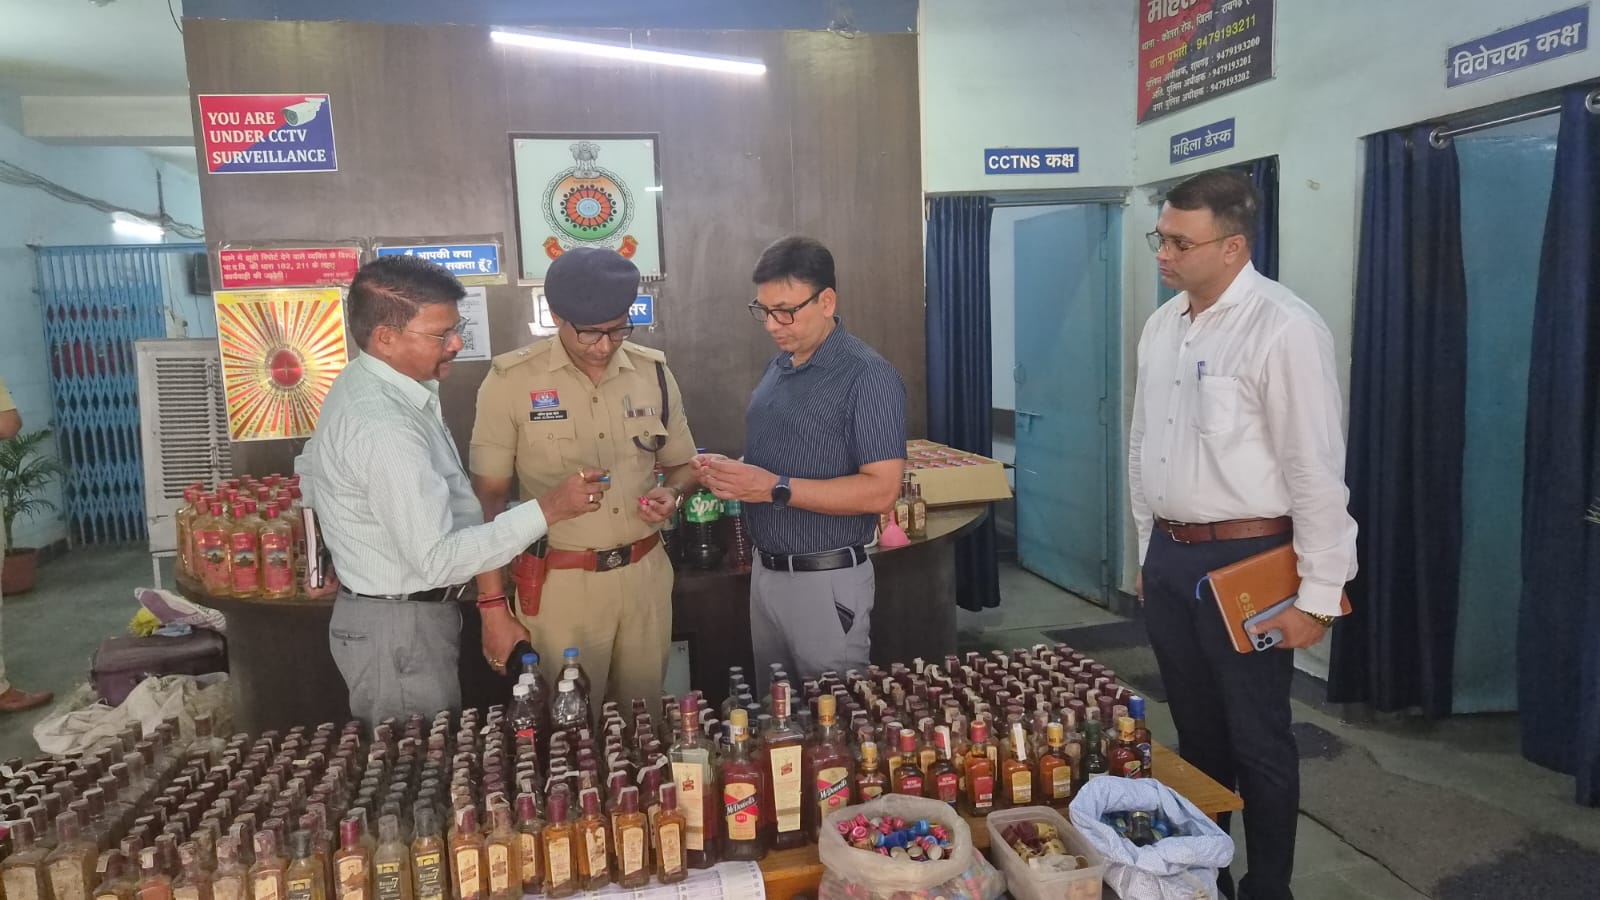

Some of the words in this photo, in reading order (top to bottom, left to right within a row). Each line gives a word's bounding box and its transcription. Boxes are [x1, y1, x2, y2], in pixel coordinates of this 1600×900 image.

[1196, 13, 1256, 50] 9479193211
[1216, 36, 1260, 62] 9479193200
[1453, 38, 1530, 78] विवेचक
[1536, 22, 1582, 53] कक्ष
[1212, 54, 1251, 78] 9479193201
[1210, 70, 1250, 93] 9479193202
[207, 112, 240, 125] YOU
[244, 112, 276, 125] ARE
[209, 130, 266, 143] UNDER
[268, 129, 308, 143] CCTV
[1172, 137, 1202, 156] महिला
[1204, 129, 1232, 148] डेस्क
[212, 149, 327, 165] SURVEILLANCE
[988, 155, 1041, 169] CCTNS
[1044, 153, 1076, 168] कक्ष
[452, 250, 472, 259] क्या
